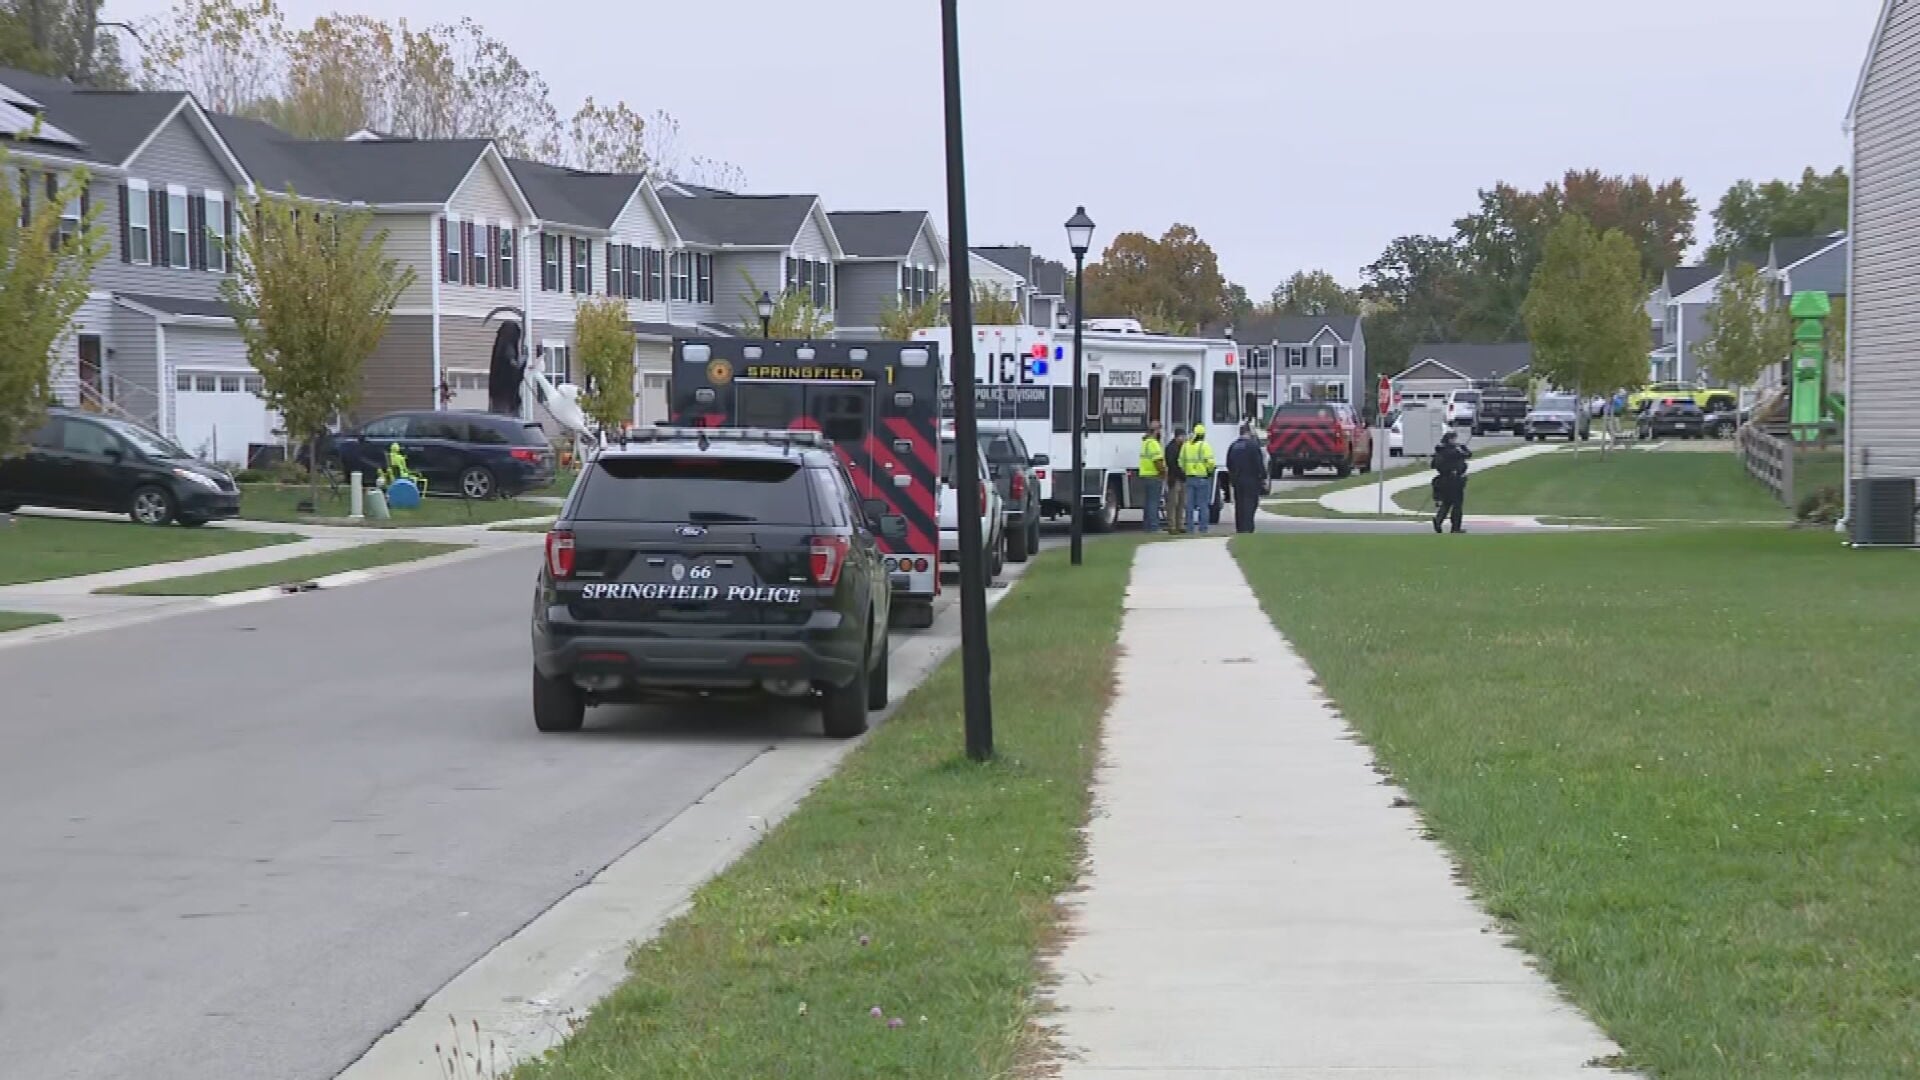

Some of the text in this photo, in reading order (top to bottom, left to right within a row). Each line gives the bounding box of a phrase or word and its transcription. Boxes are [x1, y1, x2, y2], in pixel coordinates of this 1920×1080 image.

[747, 365, 864, 380] SPRINGFIELD
[885, 364, 895, 384] 1
[975, 388, 1046, 402] POLICE DIVISION
[689, 565, 712, 580] 66
[582, 583, 801, 603] SPRINGFIELD POLICE
